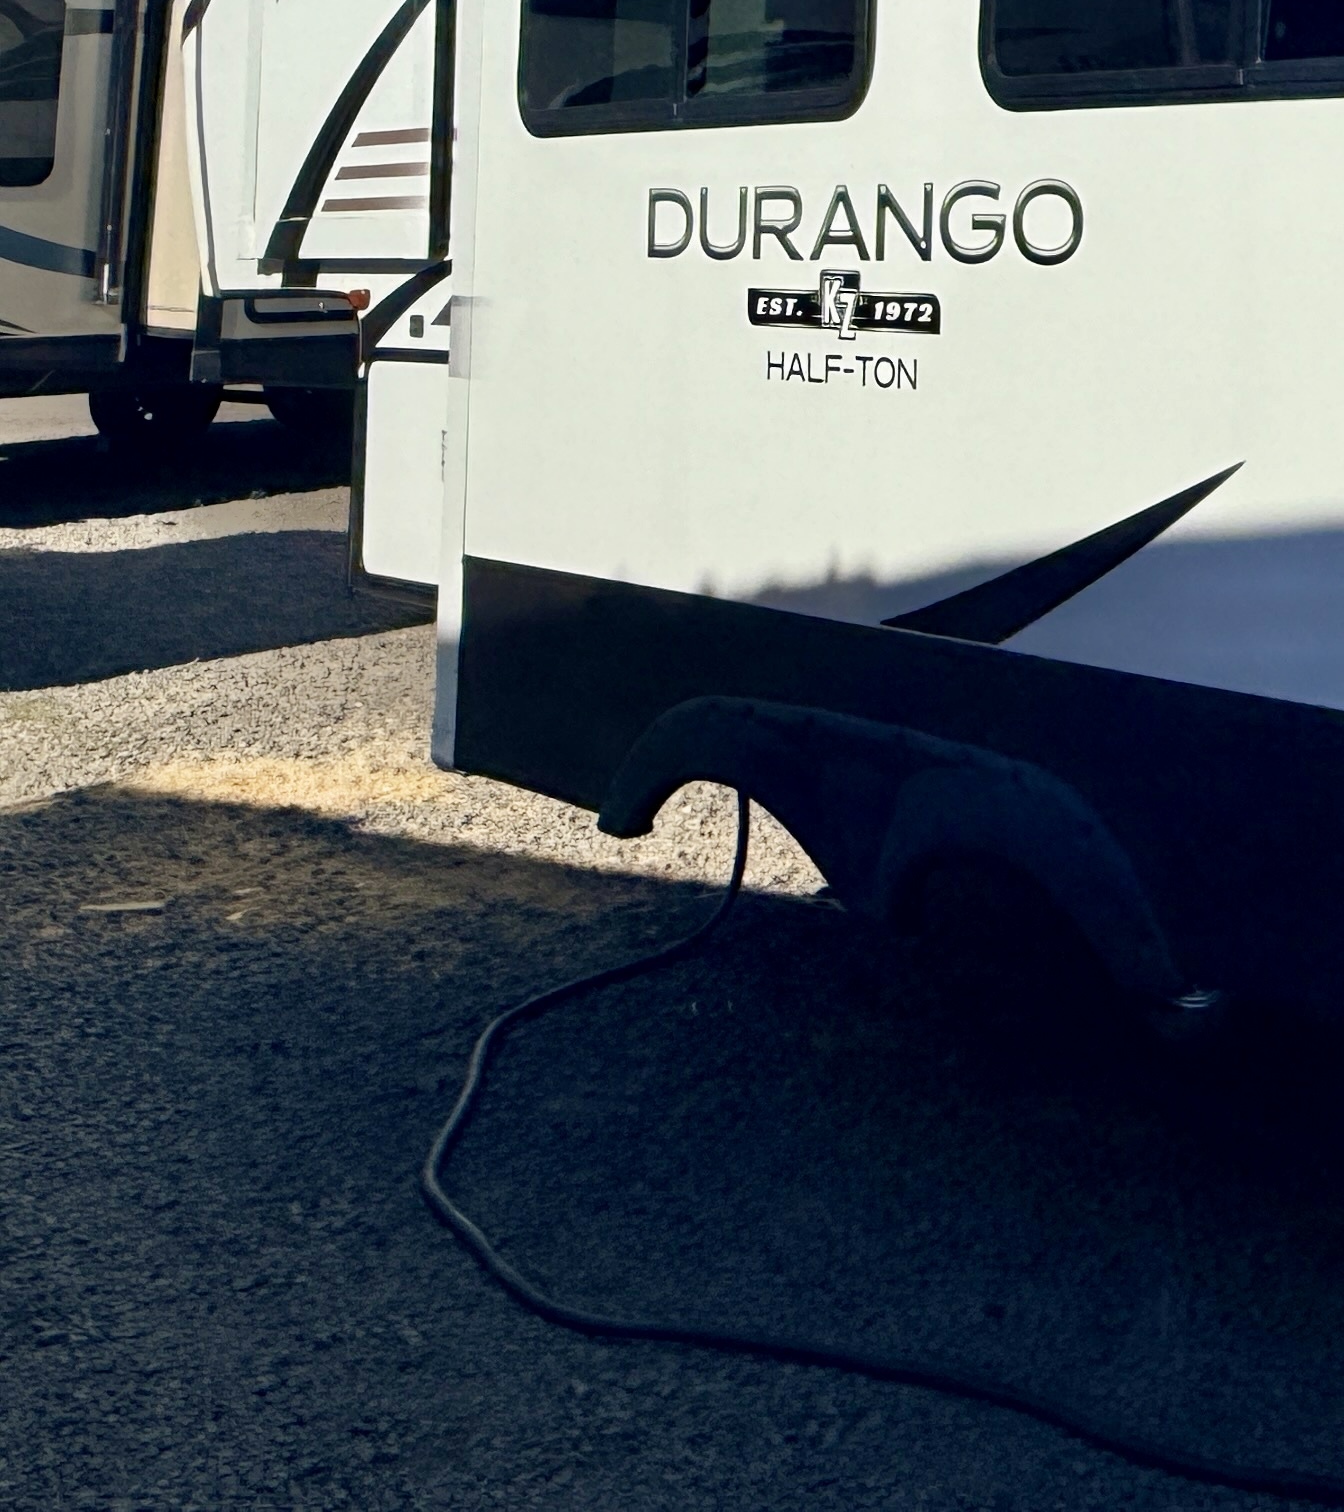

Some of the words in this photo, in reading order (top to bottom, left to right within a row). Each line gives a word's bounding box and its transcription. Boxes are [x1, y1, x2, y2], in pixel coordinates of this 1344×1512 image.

[647, 177, 1084, 266] DURANGO
[756, 296, 804, 317] EST.
[822, 276, 857, 340] KZ
[874, 300, 934, 323] 1972
[766, 350, 918, 390] HALF-TON
